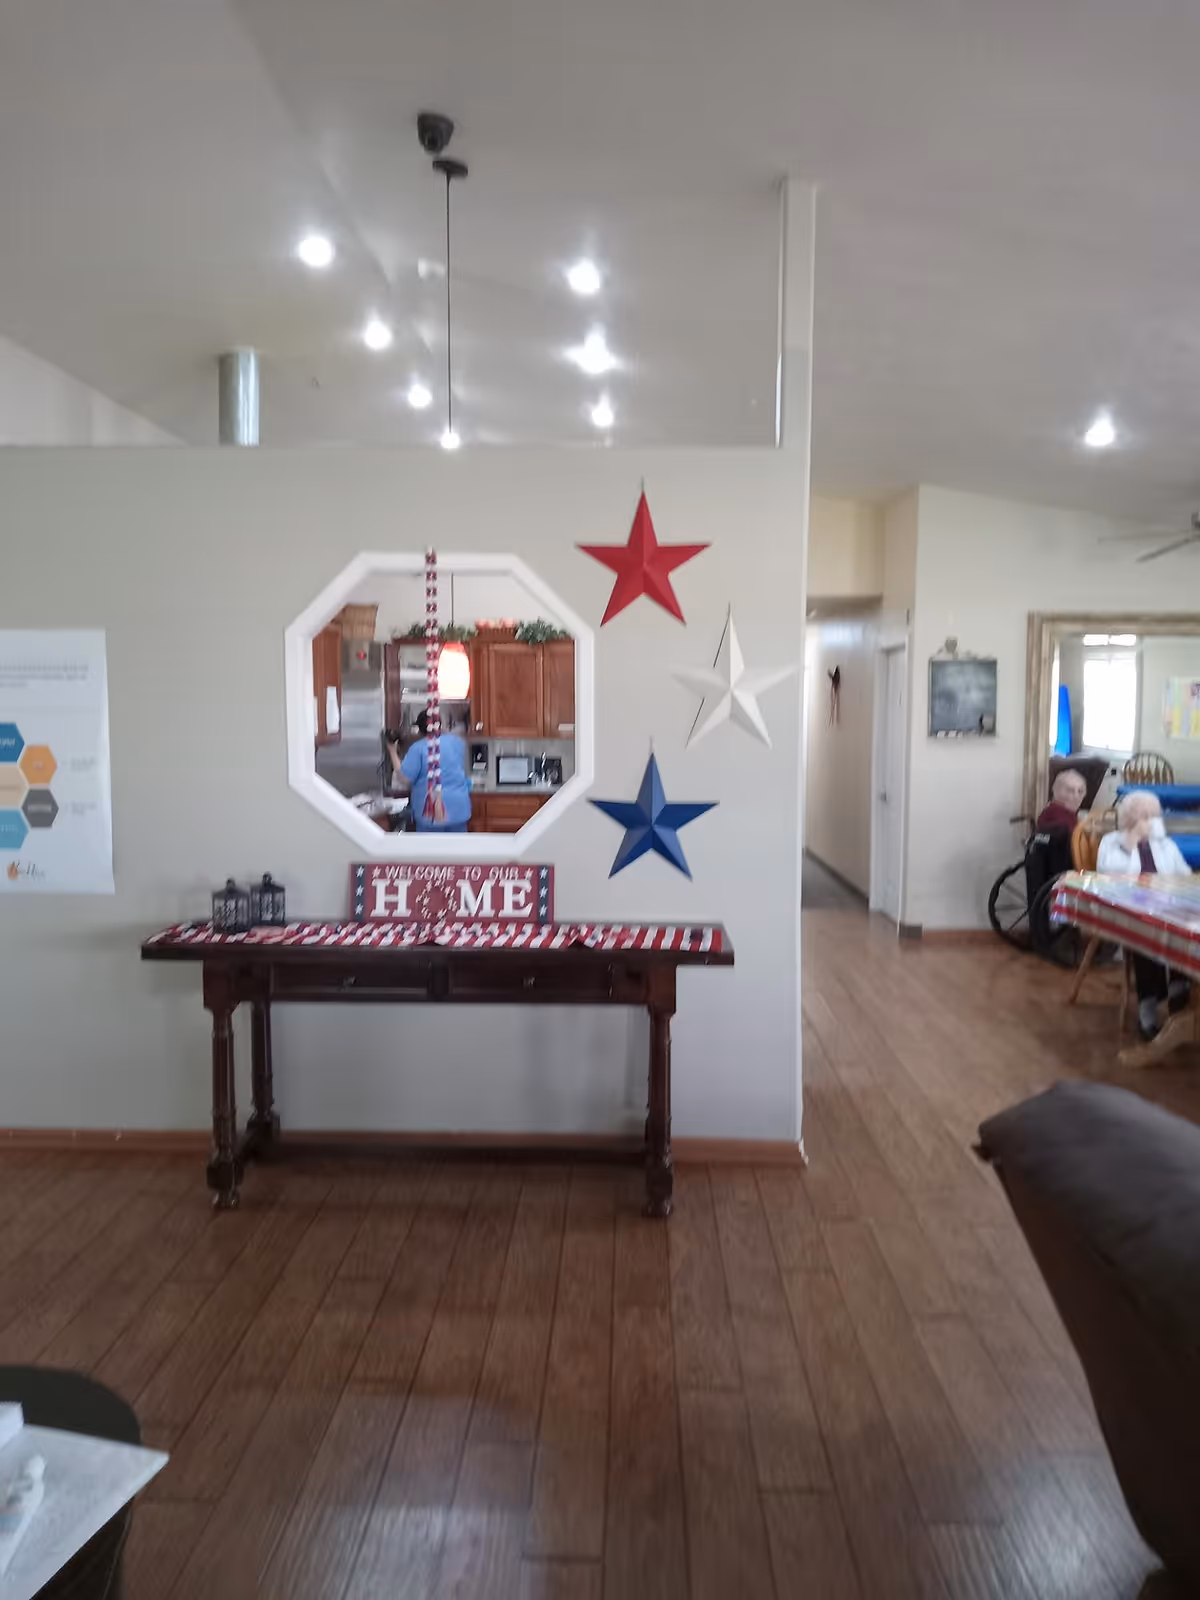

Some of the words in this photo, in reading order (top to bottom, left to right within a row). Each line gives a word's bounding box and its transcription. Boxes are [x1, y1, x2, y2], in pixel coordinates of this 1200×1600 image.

[384, 866, 455, 880] WELCOME
[463, 866, 482, 881] TO
[489, 866, 519, 881] OUR
